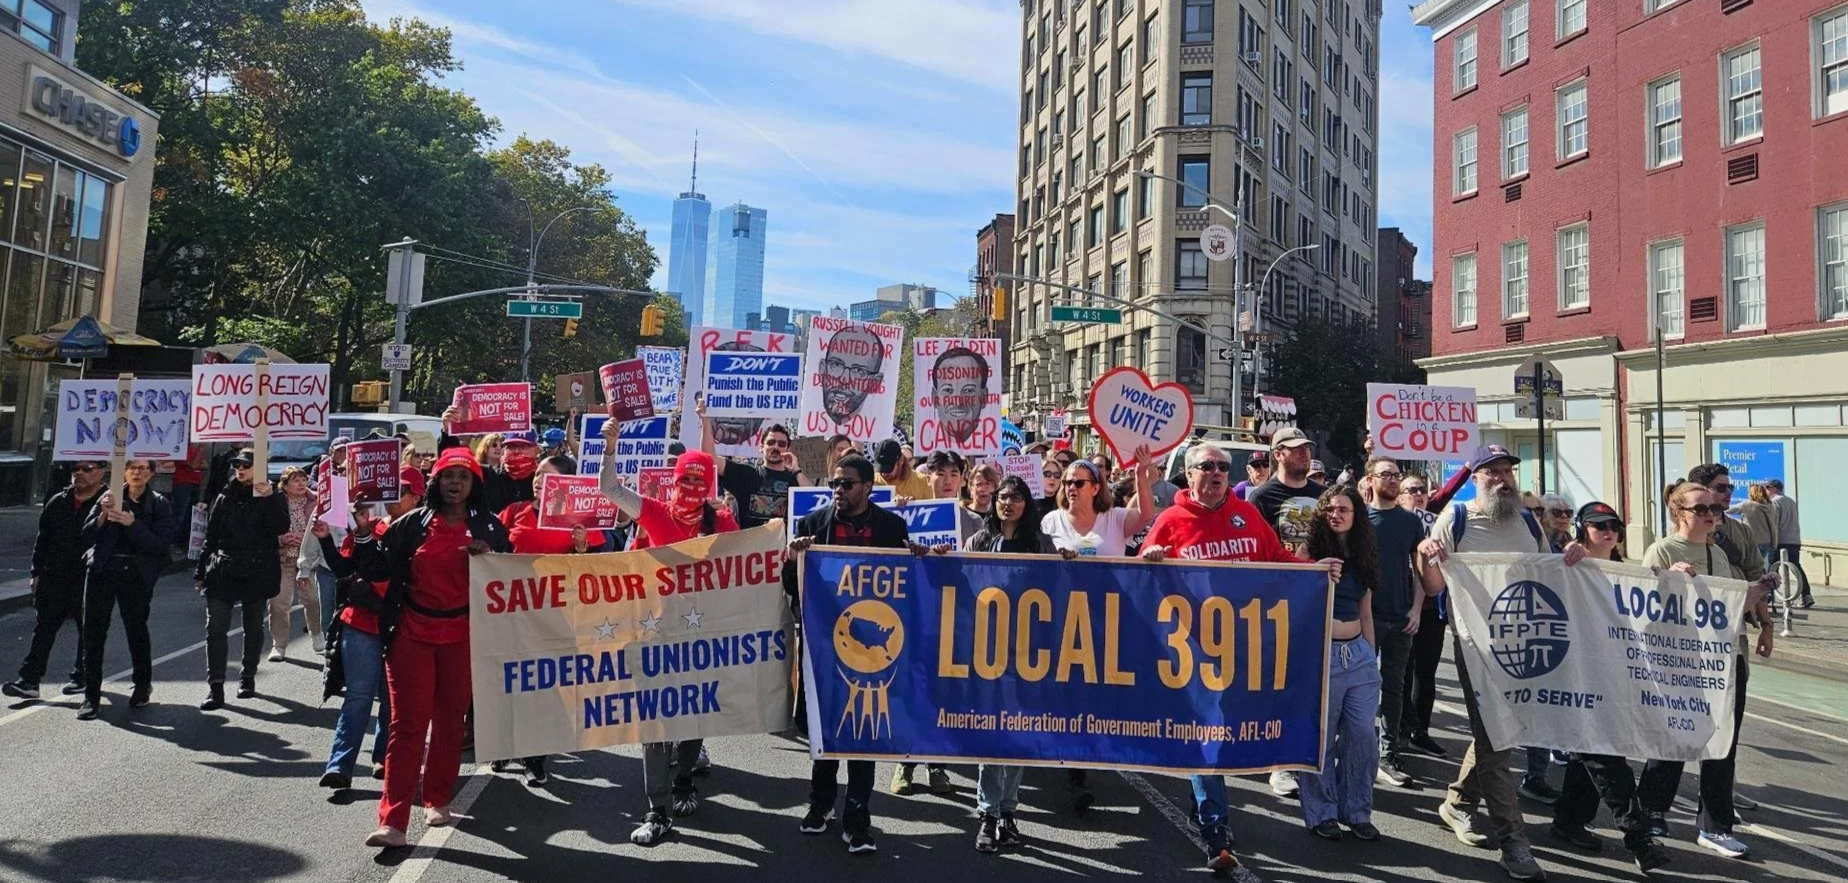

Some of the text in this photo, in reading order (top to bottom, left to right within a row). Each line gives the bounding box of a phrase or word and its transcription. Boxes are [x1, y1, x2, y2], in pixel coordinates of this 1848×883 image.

[32, 76, 121, 146] CHASE
[530, 304, 559, 314] W 4 St
[1073, 310, 1100, 320] W 4 St
[812, 316, 902, 339] RUSSELL VOUGHT
[819, 337, 869, 356] WANTED
[917, 340, 996, 356] LEE ZELDIN
[647, 353, 672, 364] BEAR
[723, 357, 788, 372] DON'T
[636, 370, 644, 379] IS
[648, 375, 674, 387] AITH
[928, 366, 993, 381] POISONING
[196, 373, 327, 396] LONG REIGN
[623, 384, 638, 394] FOR
[708, 376, 798, 391] Punish the Public
[67, 389, 190, 415] DEMOCRACY
[472, 392, 526, 402] DEMOCRACY IS
[625, 394, 647, 408] SALE!
[706, 394, 797, 409] Fund the US EPA!
[920, 395, 940, 407] OUR
[1121, 384, 1175, 418] WORKERS
[1398, 386, 1453, 402] Don't be a
[196, 401, 328, 432] DEMOCRACY
[480, 402, 518, 415] NOT FOR
[504, 412, 525, 421] SALE!
[1376, 394, 1476, 423] CHICKEN
[807, 411, 876, 438] US GOV
[1110, 403, 1168, 441] UNITE
[1416, 422, 1426, 431] in
[76, 415, 185, 453] NOW!
[920, 417, 998, 452] CANCER
[1379, 422, 1469, 453] COUP
[391, 451, 396, 460] IS
[583, 441, 664, 455] Puni the Public
[1724, 450, 1756, 460] Premier
[581, 460, 600, 474] Fun
[626, 460, 639, 474] US
[1006, 464, 1034, 472] Russell
[1008, 456, 1030, 464] STOP
[358, 464, 390, 480] NOT FOR
[377, 477, 395, 488] SALE!
[569, 486, 604, 495] DEMOCR
[574, 497, 597, 510] NOT
[596, 508, 614, 518] SALE!
[1180, 537, 1258, 560] SOLIDARITY
[485, 549, 788, 614] SAVE OUR SERVICE
[837, 565, 908, 598] AFGE
[1614, 584, 1728, 630] LOCAL 98
[1488, 622, 1568, 639] IFPTE
[938, 586, 1289, 692] LOCAL 3911
[504, 630, 787, 694] FEDERAL UNIONISTS
[1627, 647, 1641, 660] OF
[1700, 659, 1725, 671] AND
[1671, 674, 1725, 690] ENGINEERS
[584, 680, 721, 729] NETWORK
[1514, 688, 1531, 704] TO
[1537, 688, 1603, 709] SERVE"
[1665, 694, 1686, 711] York
[1689, 698, 1711, 716] City
[937, 707, 1282, 745] American Federation of Government Employees, AFL-CIO
